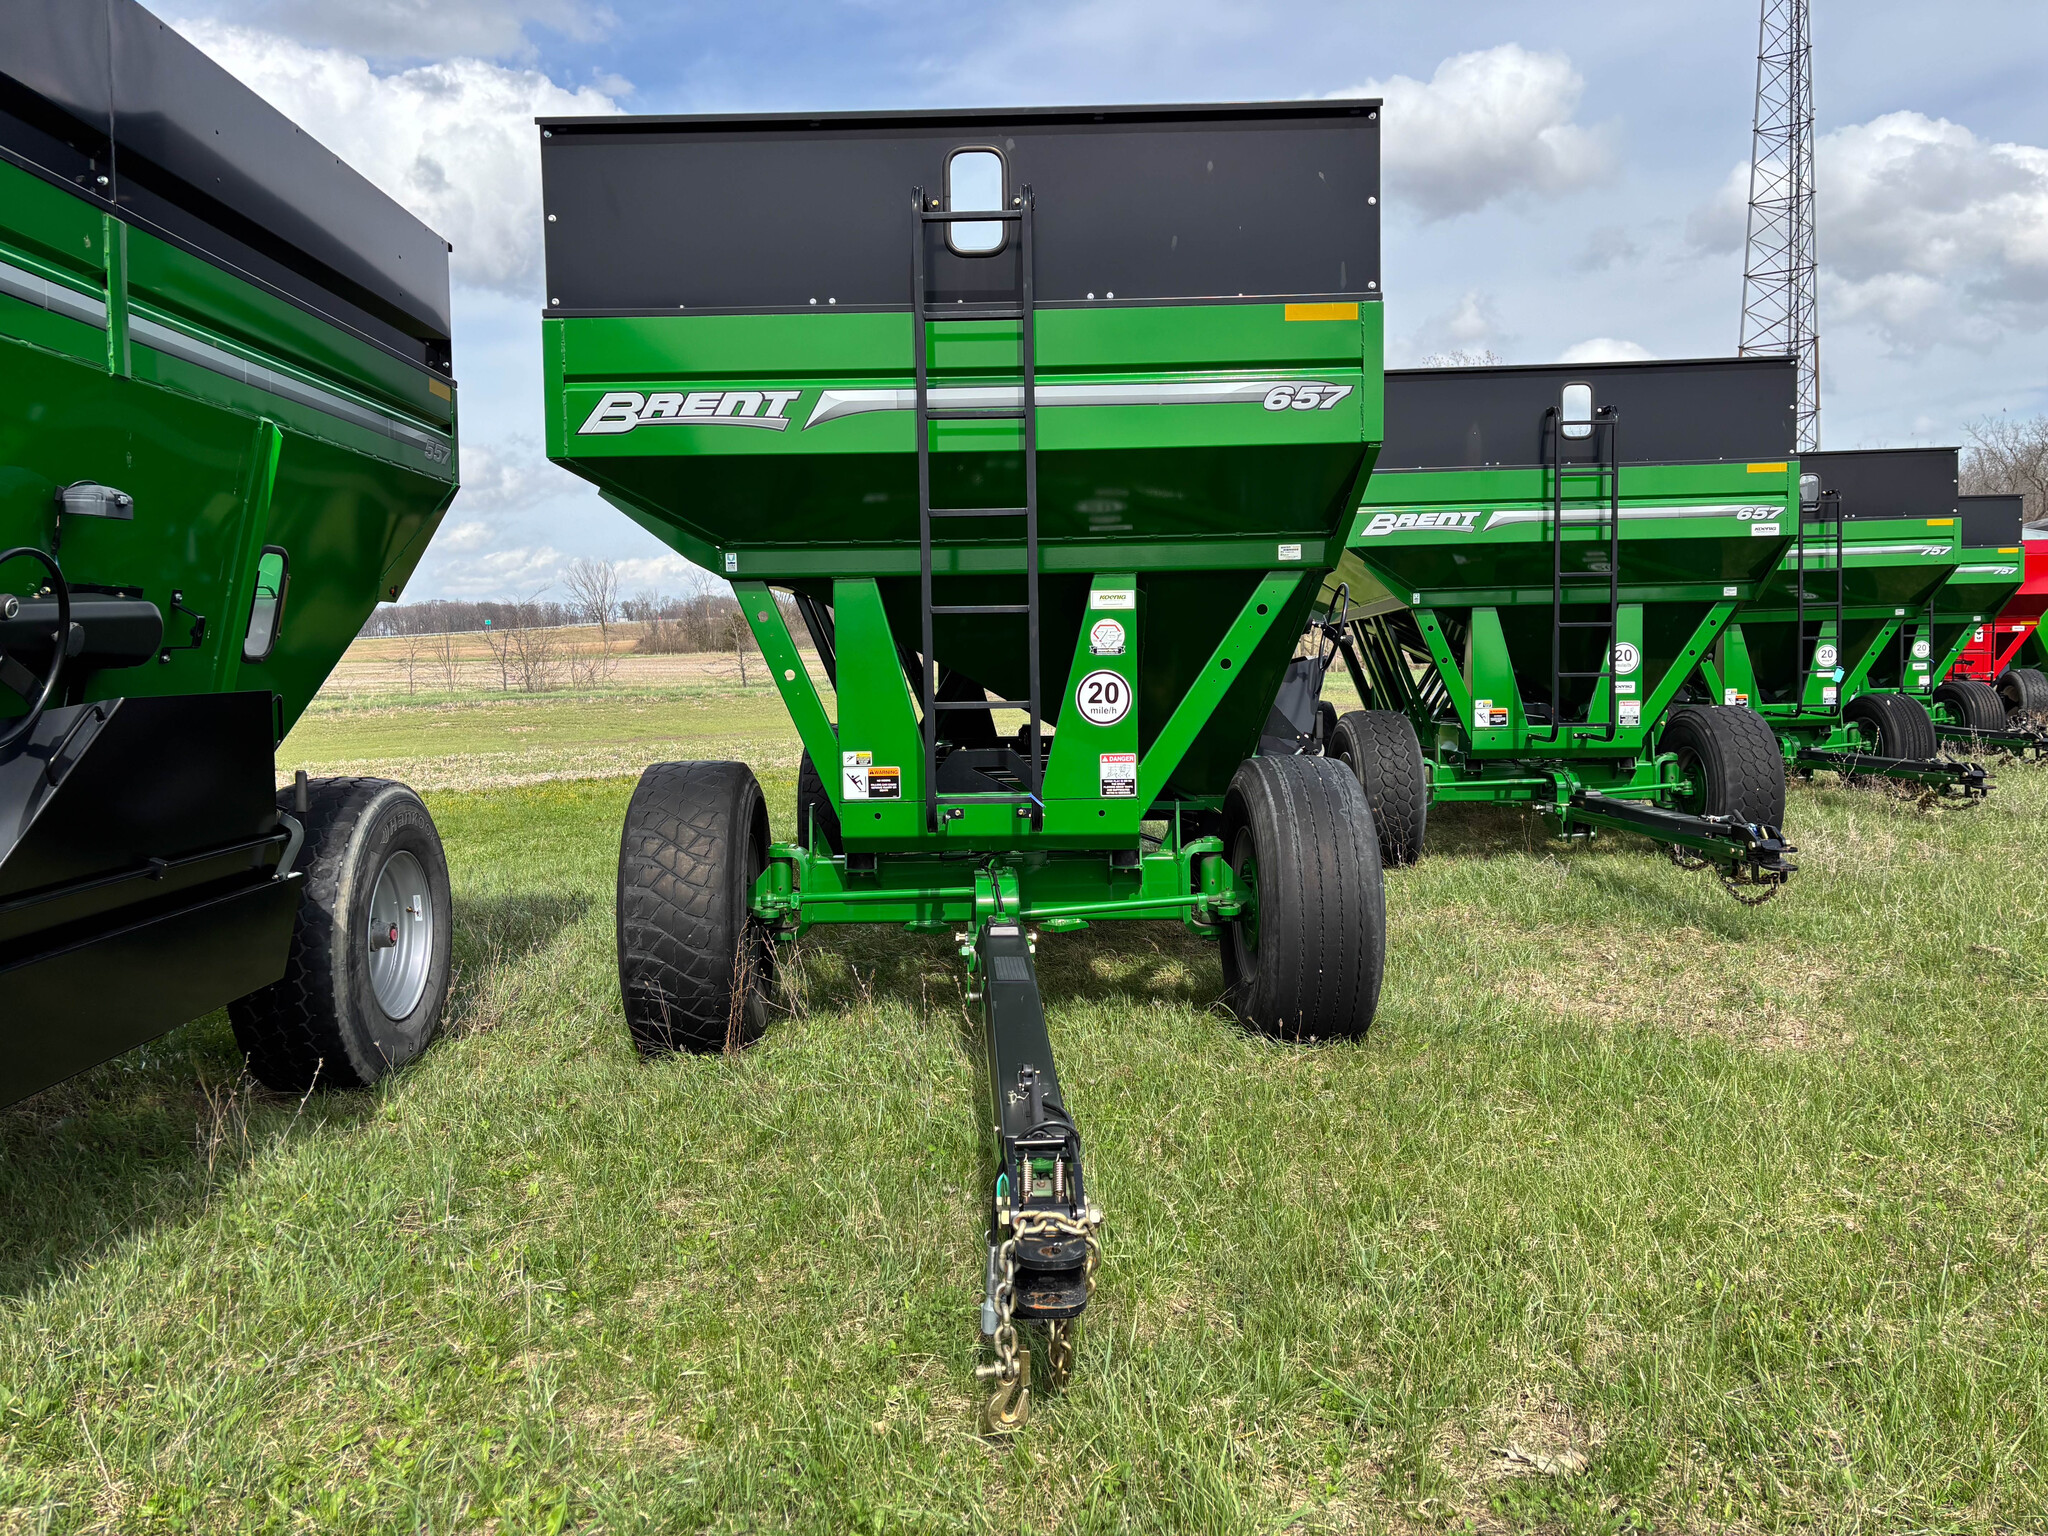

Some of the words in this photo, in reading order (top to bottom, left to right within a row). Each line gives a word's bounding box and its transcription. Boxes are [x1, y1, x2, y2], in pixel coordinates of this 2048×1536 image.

[1263, 384, 1355, 412] 657
[575, 390, 803, 435] BRENT
[424, 438, 452, 465] 557
[1736, 506, 1787, 521] 657
[1360, 511, 1482, 537] BRENT
[1920, 546, 1953, 555] 757
[1993, 567, 2018, 575] 757
[1615, 649, 1633, 661] 20
[1821, 650, 1834, 658] 20
[1088, 681, 1120, 704] 20
